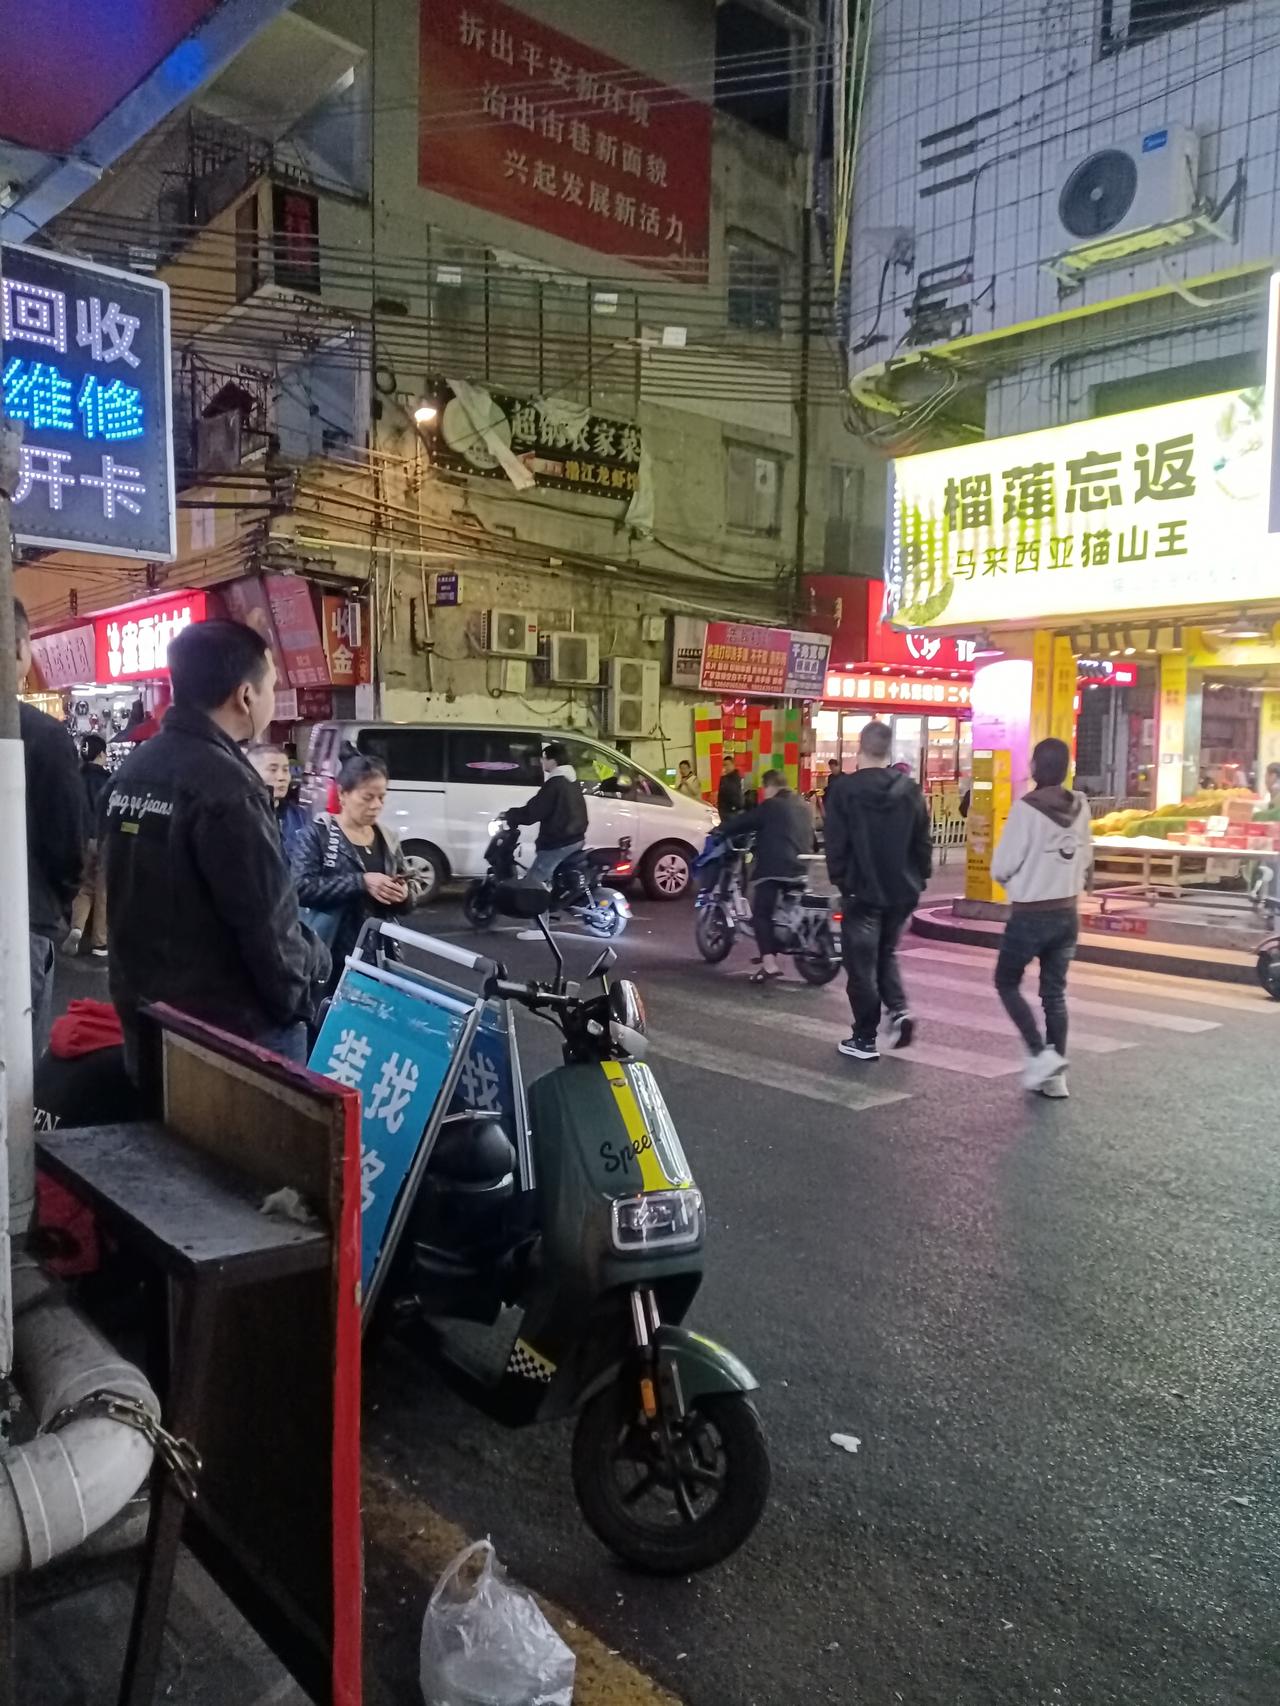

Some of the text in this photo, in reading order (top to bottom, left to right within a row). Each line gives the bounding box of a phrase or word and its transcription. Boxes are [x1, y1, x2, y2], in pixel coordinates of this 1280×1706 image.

[459, 8, 650, 128] 拆出平安新环境
[503, 148, 684, 243] 兴起发展新活力
[2, 277, 142, 369] 回收
[2, 356, 145, 441] 维修
[10, 444, 147, 519] 开卡
[943, 433, 1197, 532] 榴莲忘返
[952, 519, 1188, 582] 马来西亚猫山王
